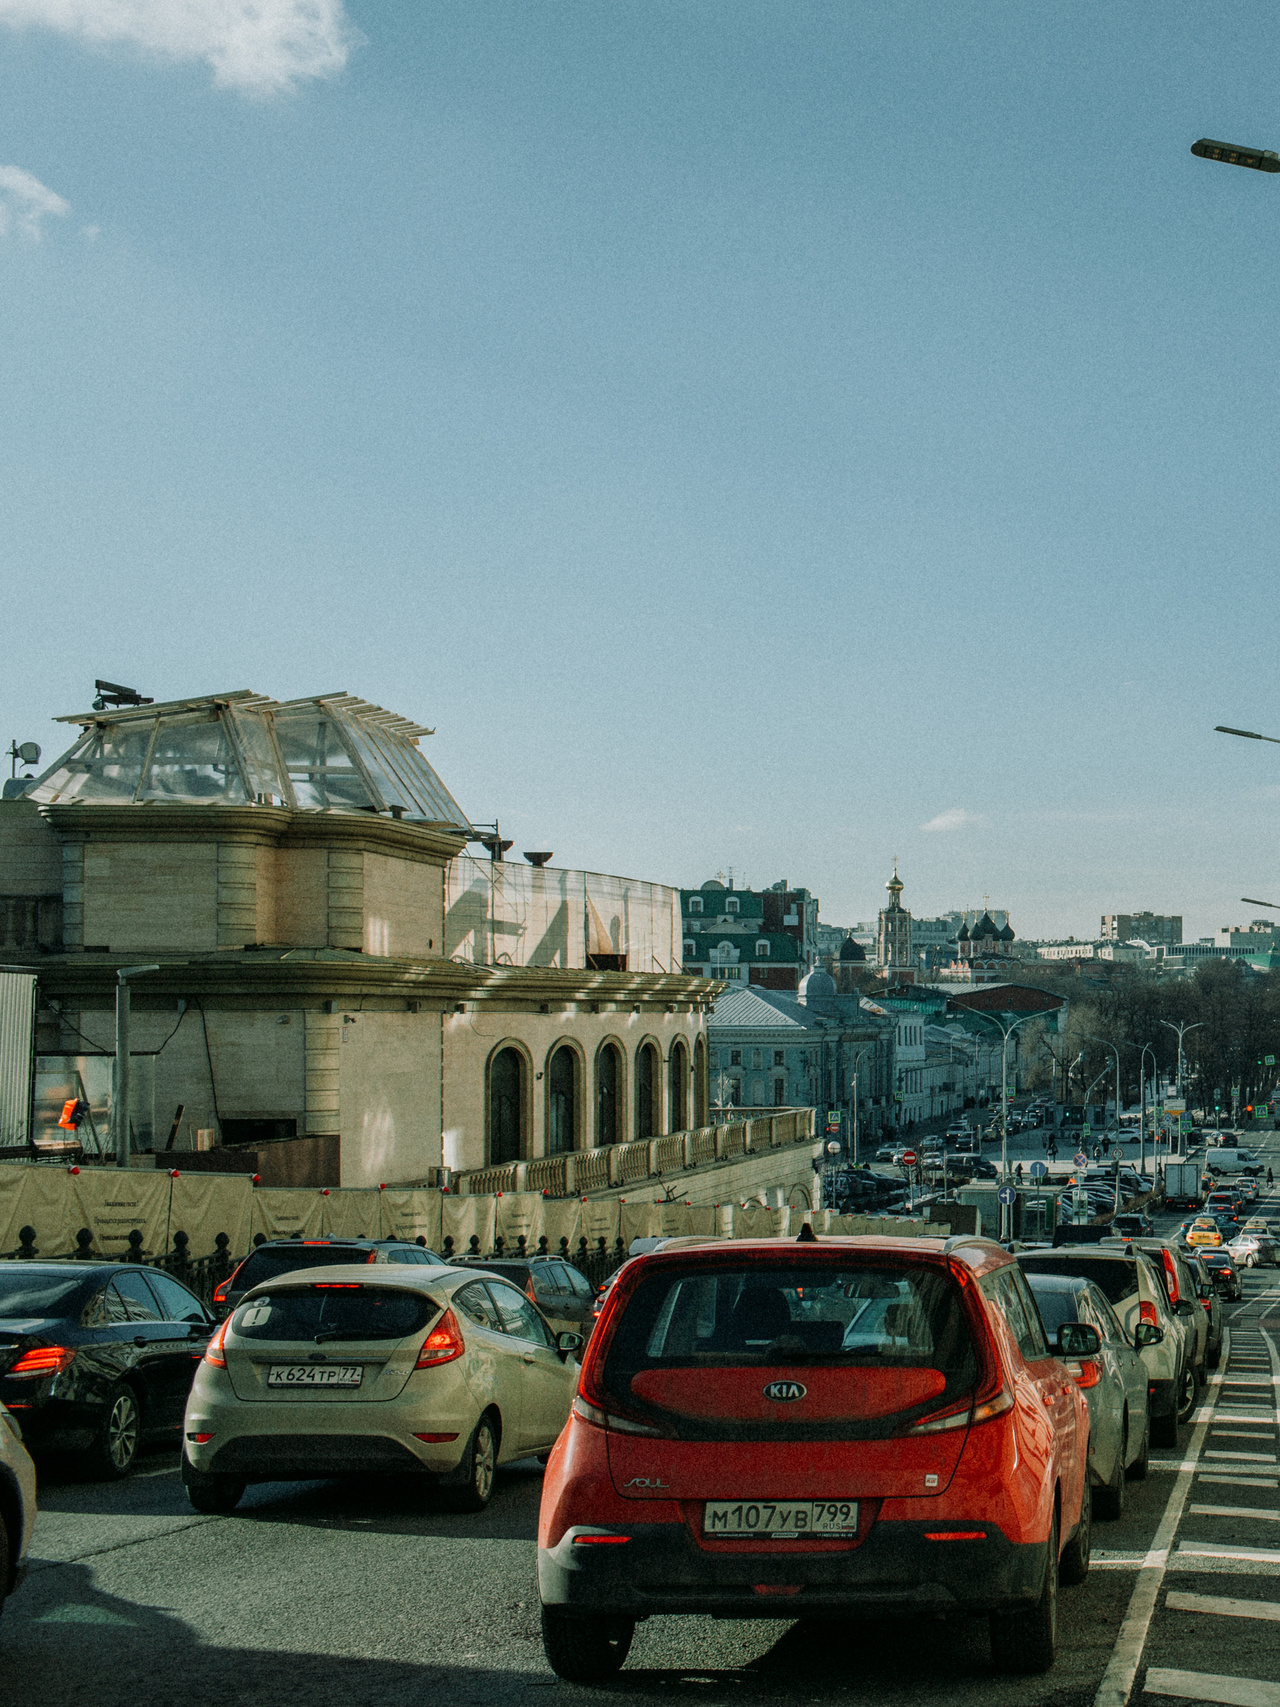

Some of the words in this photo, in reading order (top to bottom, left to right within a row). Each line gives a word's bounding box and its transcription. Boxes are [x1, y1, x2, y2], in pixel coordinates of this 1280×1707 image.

[274, 1367, 337, 1382] К624ТР
[342, 1367, 358, 1378] 77
[770, 1384, 800, 1398] KIA
[711, 1504, 808, 1530] М107УВ
[815, 1503, 851, 1522] 799
[822, 1522, 841, 1530] RUS
